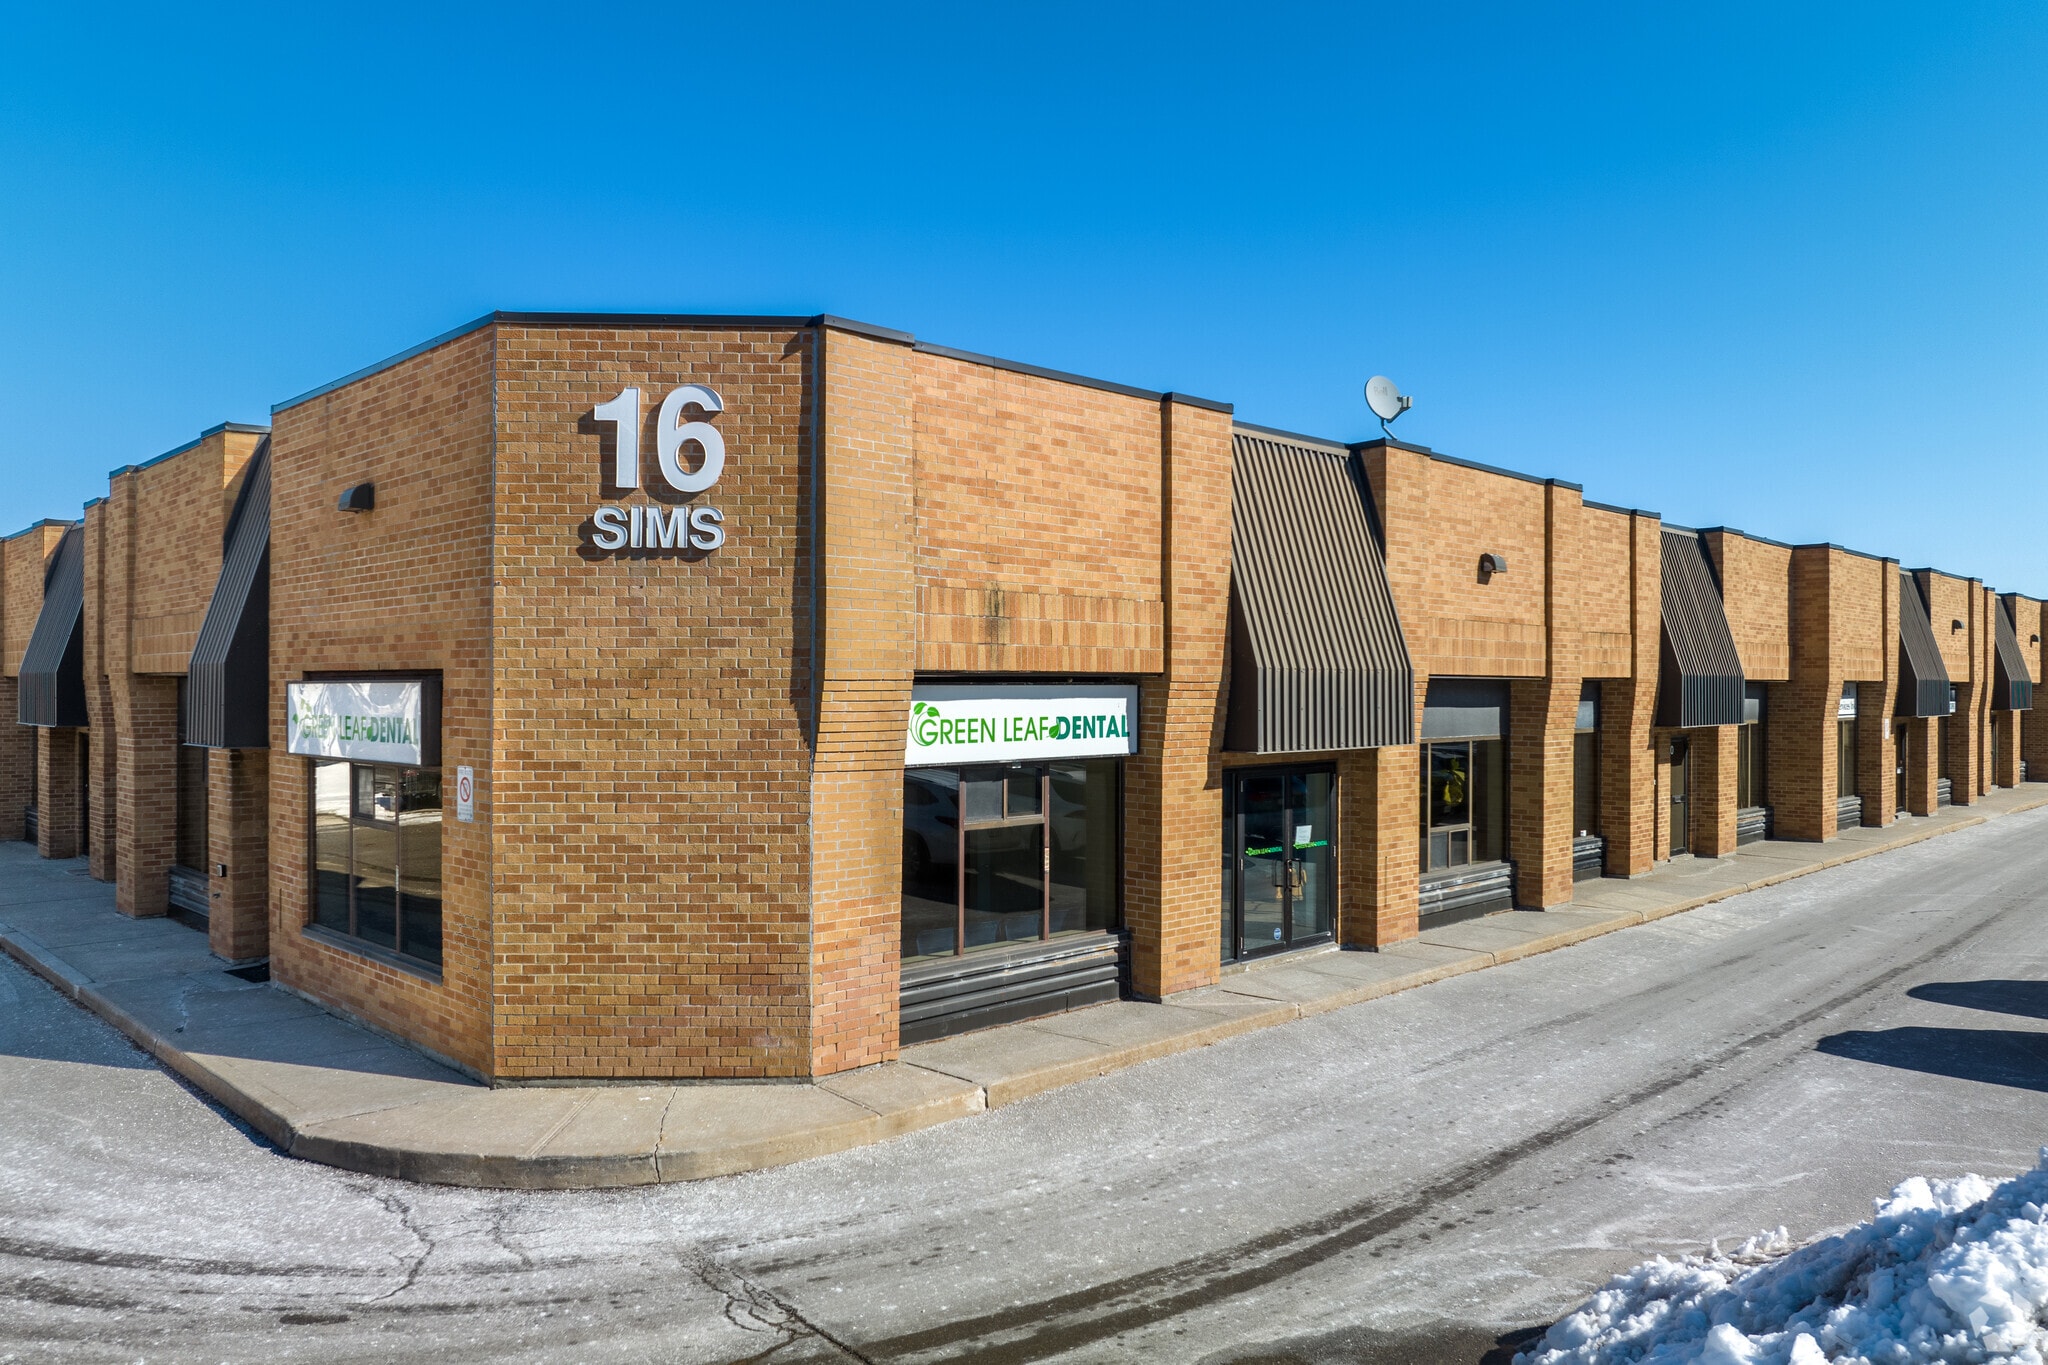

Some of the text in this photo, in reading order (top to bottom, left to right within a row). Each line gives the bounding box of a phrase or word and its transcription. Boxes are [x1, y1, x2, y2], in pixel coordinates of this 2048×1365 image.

[594, 384, 725, 492] 16
[592, 505, 725, 550] SIMS
[339, 715, 366, 741] LEAF
[371, 716, 418, 744] DENTAL
[918, 714, 1130, 746] GREEN LEAF DENTAL
